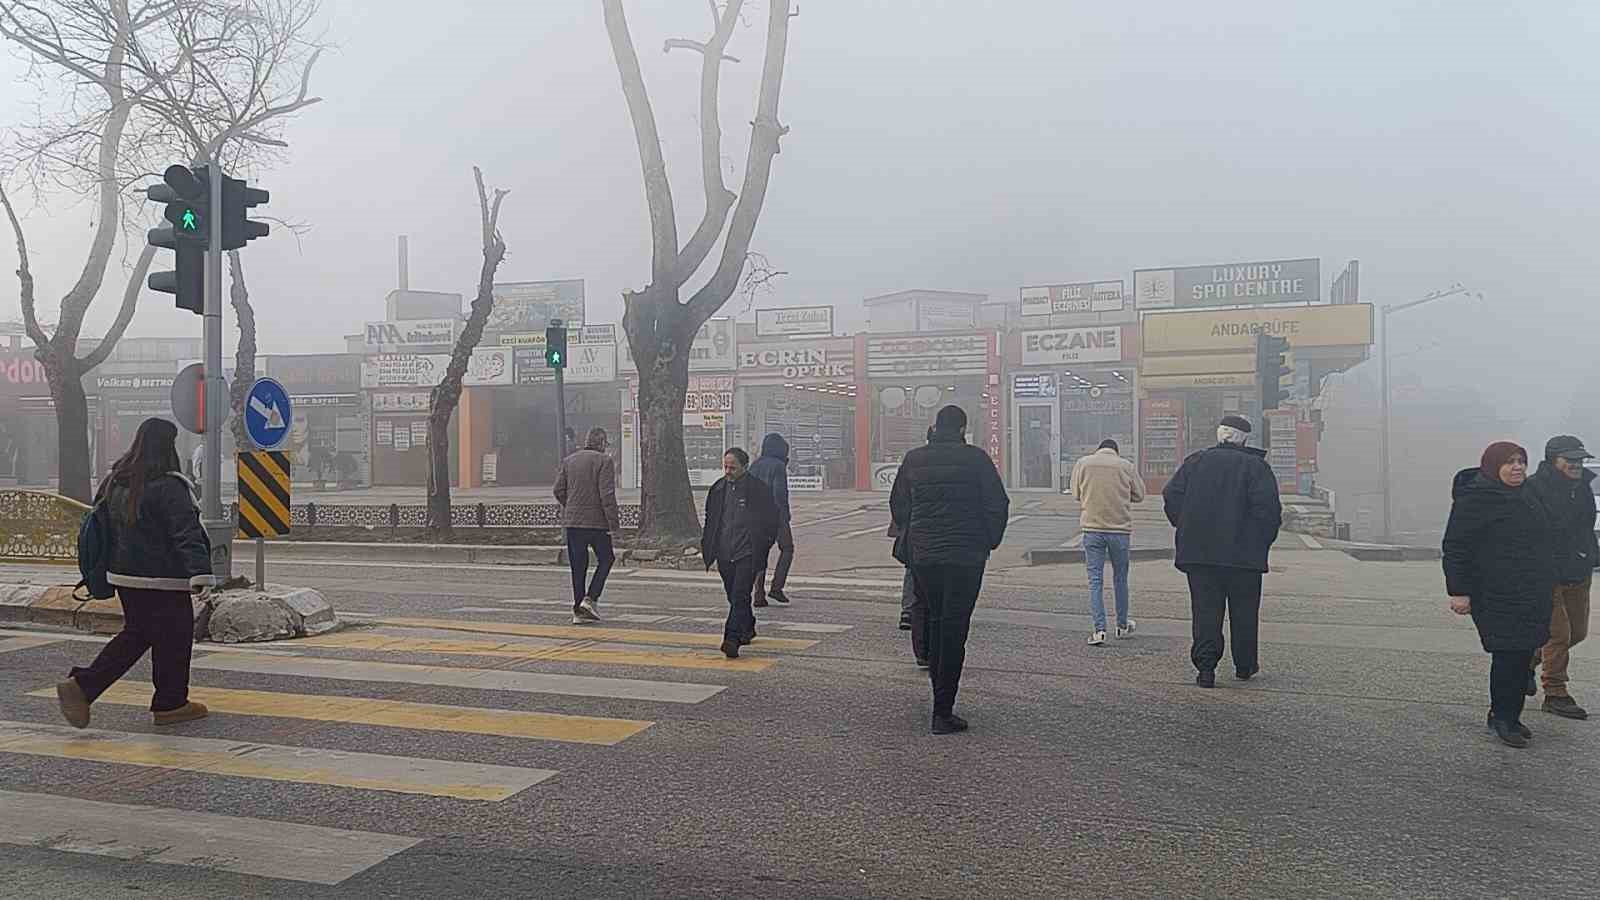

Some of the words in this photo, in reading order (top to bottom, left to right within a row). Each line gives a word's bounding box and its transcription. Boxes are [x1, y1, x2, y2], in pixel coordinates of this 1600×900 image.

[1212, 264, 1282, 283] LUXURY
[1233, 278, 1305, 297] CENTRE
[1026, 330, 1117, 353] ECZANE
